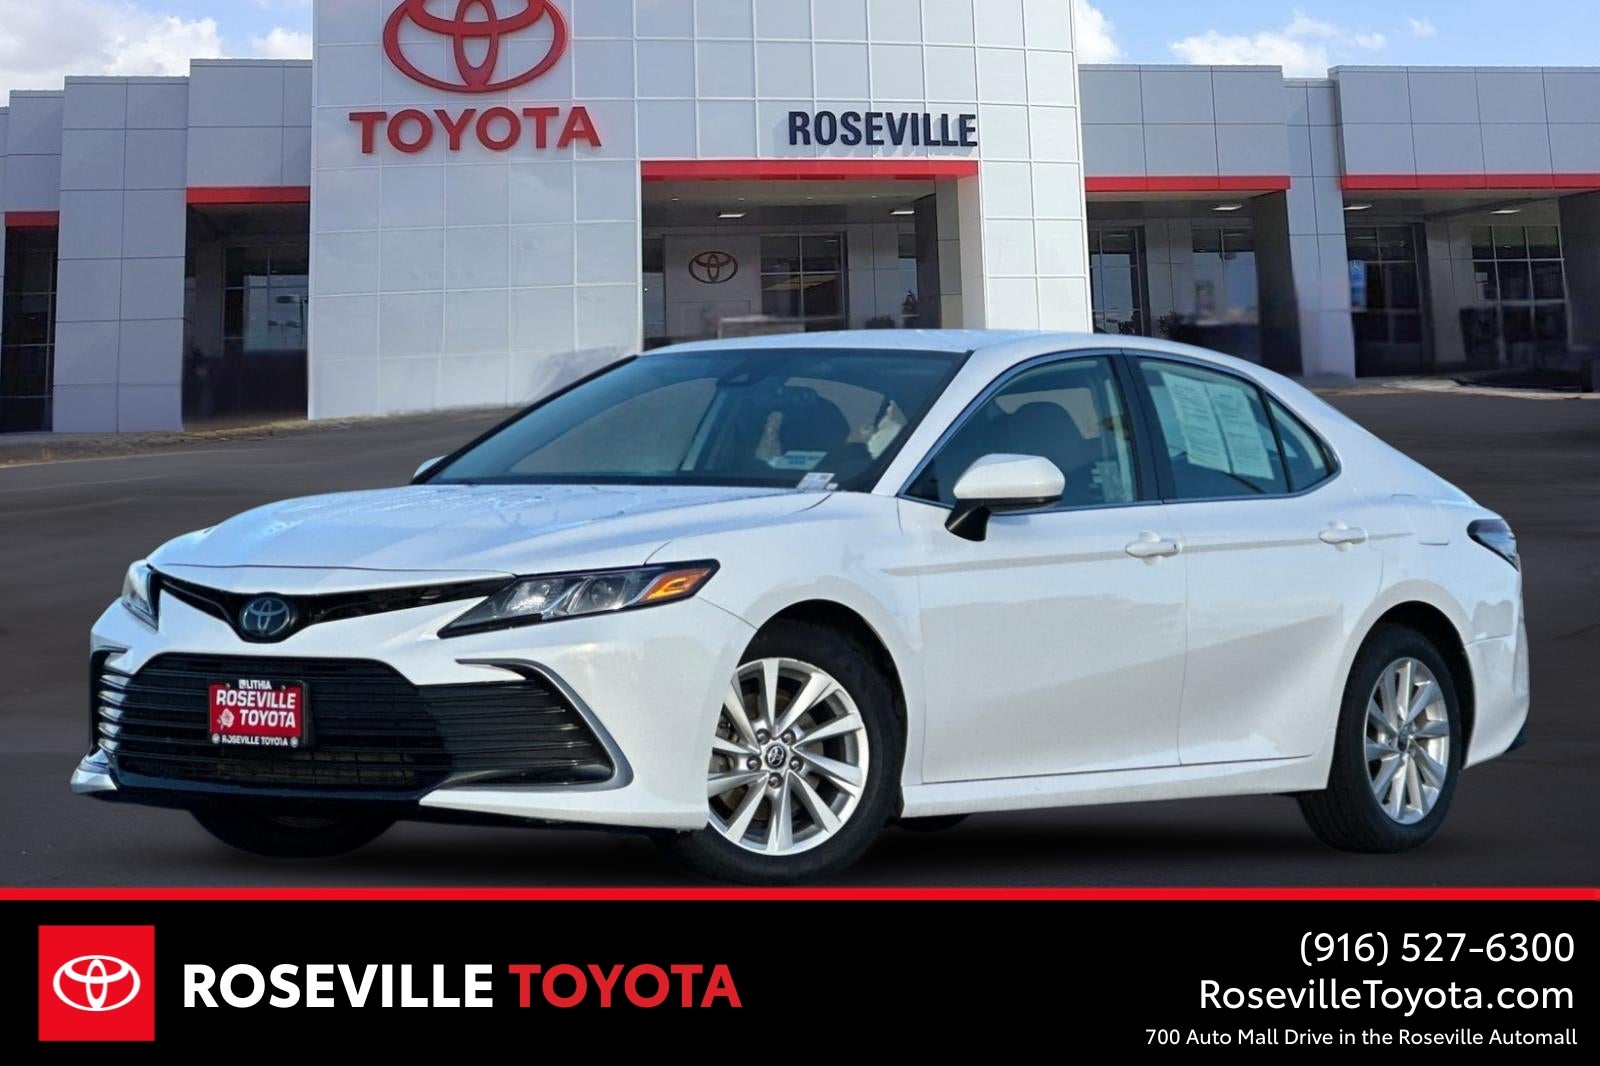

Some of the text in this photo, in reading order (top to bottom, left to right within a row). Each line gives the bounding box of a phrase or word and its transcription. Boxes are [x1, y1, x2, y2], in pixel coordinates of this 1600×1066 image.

[349, 106, 602, 154] TOYOTA
[788, 110, 978, 148] ROSEVILLE
[246, 679, 272, 690] LITHIA
[216, 689, 297, 709] ROSEVILLE
[240, 709, 296, 728] TOYOTA
